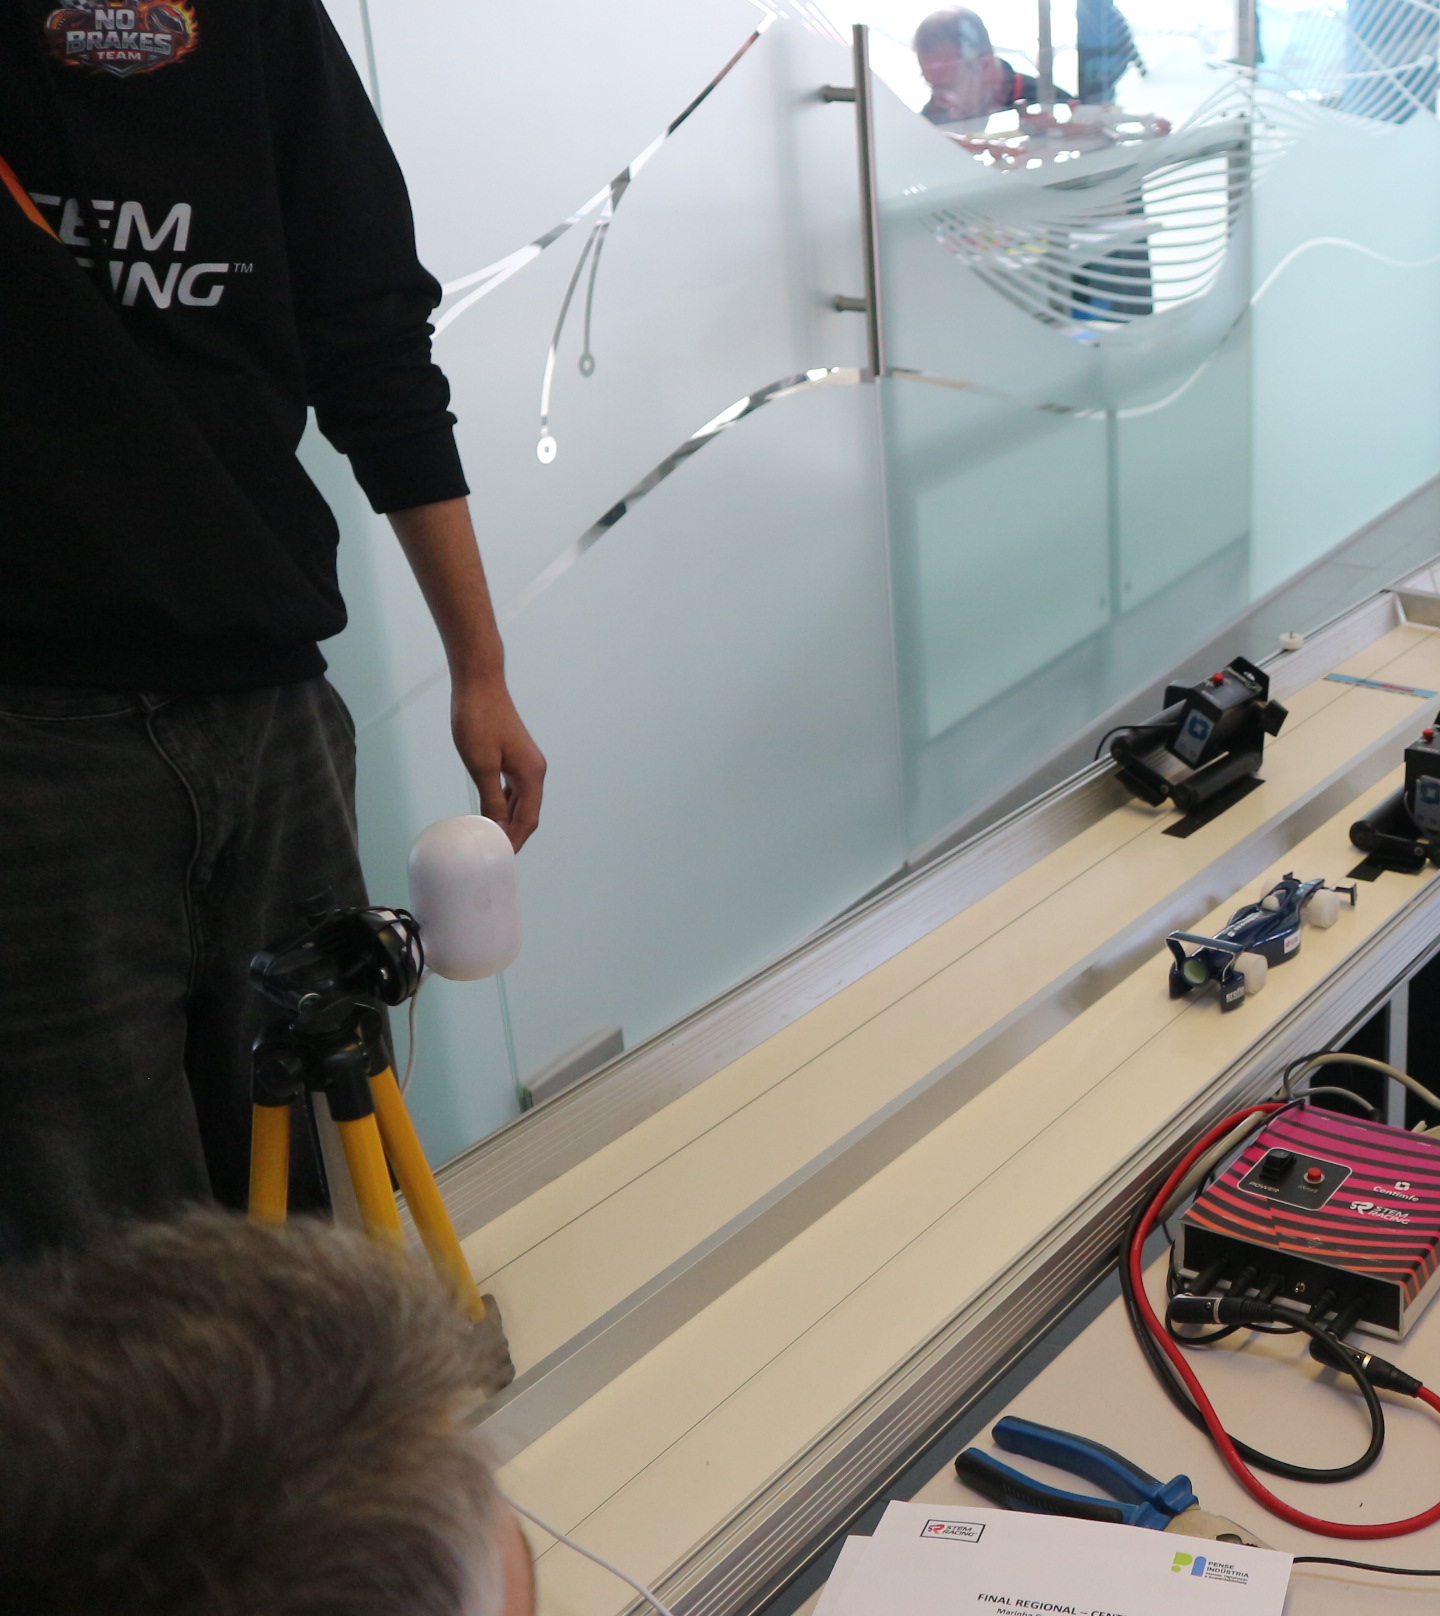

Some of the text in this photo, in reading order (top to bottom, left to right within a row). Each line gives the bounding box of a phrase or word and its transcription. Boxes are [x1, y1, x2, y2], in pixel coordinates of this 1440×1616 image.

[94, 8, 136, 30] NO
[65, 30, 172, 56] BRAKES
[96, 51, 141, 60] TEAM
[1248, 1181, 1281, 1194] POWER
[1373, 1186, 1420, 1203] Centimfe
[1368, 1211, 1411, 1225] RACING
[1374, 1206, 1409, 1218] STEM
[1207, 1561, 1235, 1570] PENSE
[977, 1593, 1012, 1606] FINAL
[1015, 1599, 1077, 1615] REGIONAL
